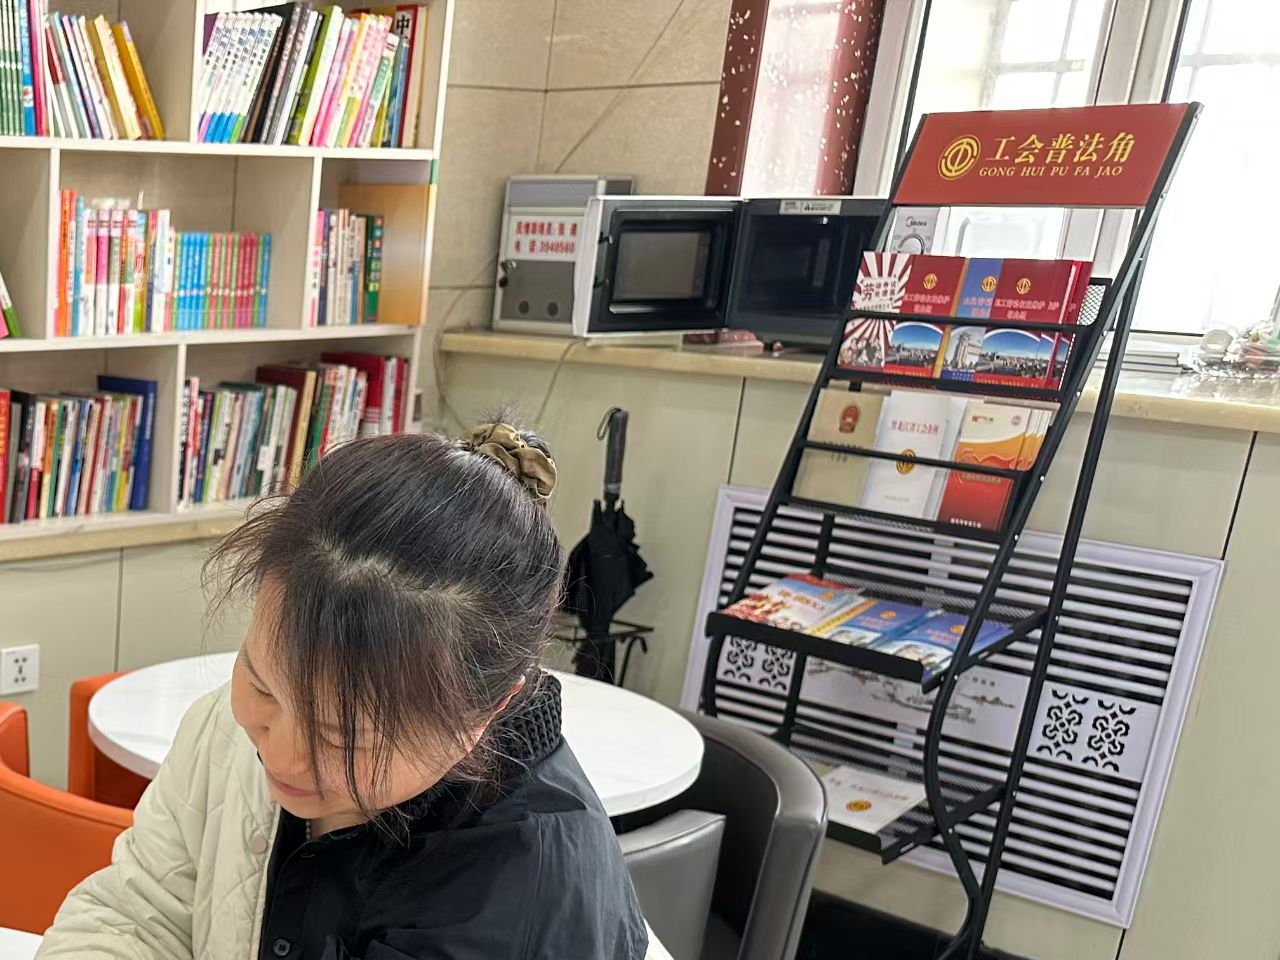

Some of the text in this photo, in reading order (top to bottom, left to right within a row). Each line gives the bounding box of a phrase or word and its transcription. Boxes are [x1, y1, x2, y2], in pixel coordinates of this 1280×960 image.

[985, 132, 1135, 164] 工会普法角
[979, 166, 1123, 177] GONG HUI PU FA JAO
